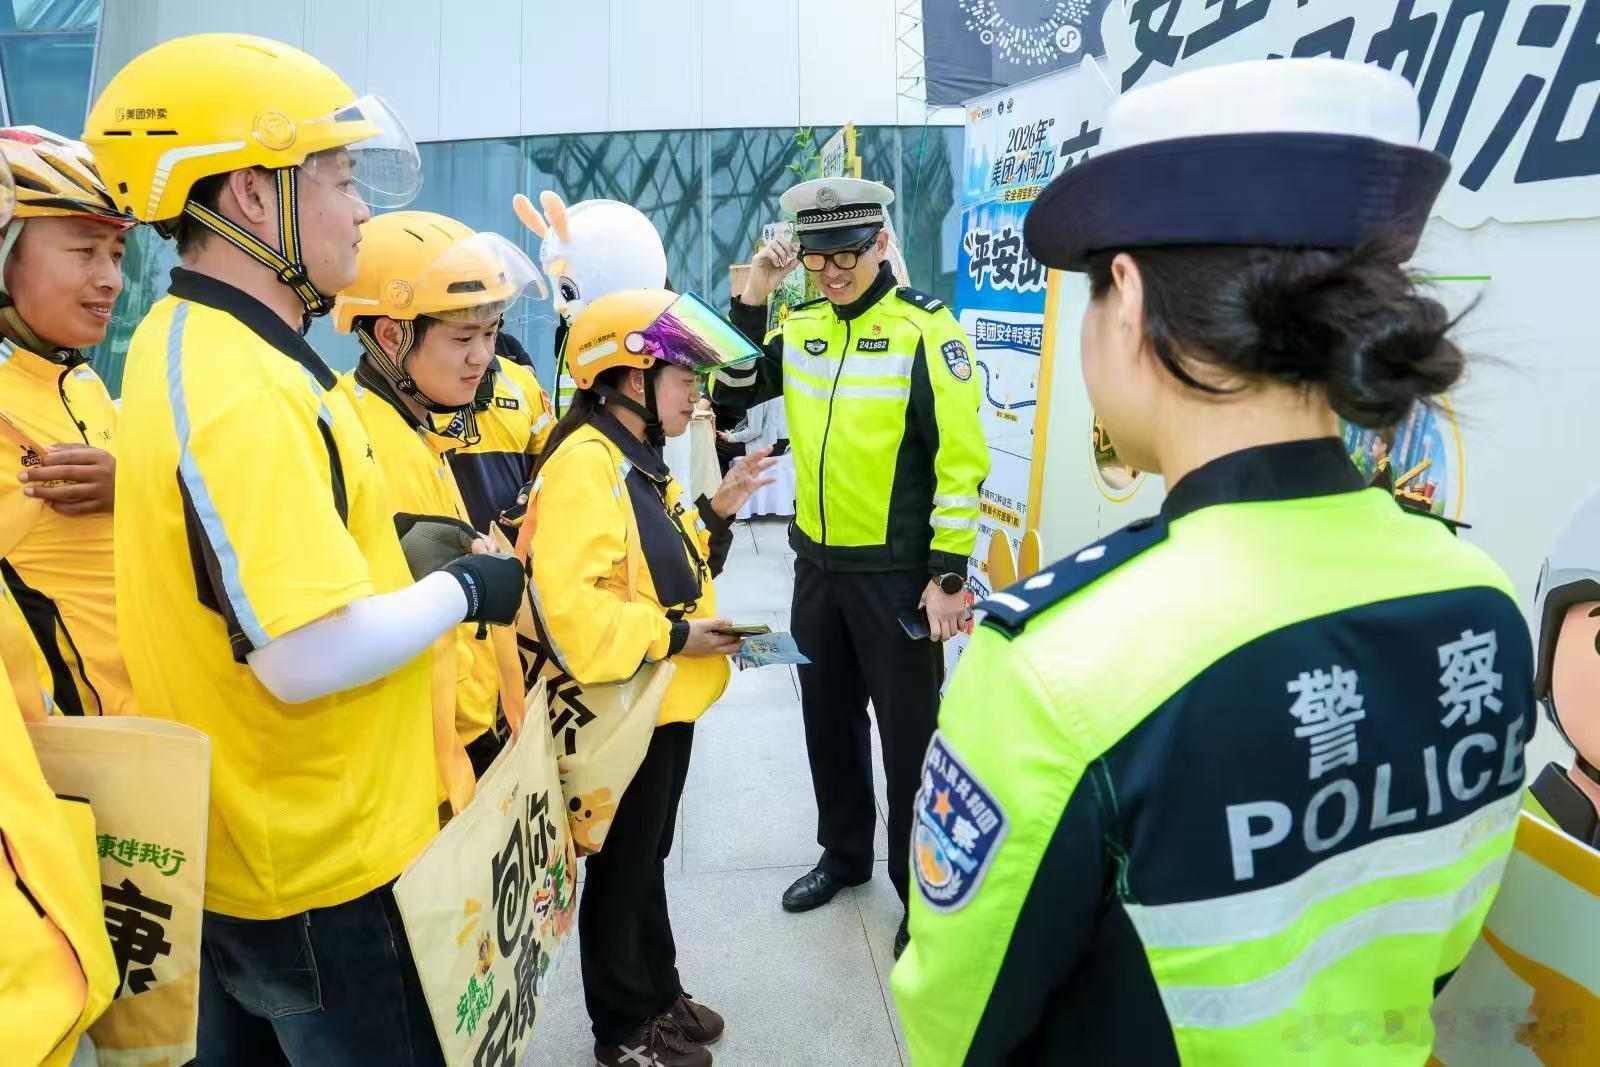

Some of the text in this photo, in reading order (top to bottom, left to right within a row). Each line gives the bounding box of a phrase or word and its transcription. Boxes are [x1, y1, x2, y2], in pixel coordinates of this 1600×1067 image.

[1005, 118, 1048, 154] 2026年
[991, 149, 1055, 188] 美团不闯红
[970, 226, 1048, 288] 平安出
[976, 320, 1043, 348] 美团安全寻宝季活
[1225, 713, 1527, 882] POLICE
